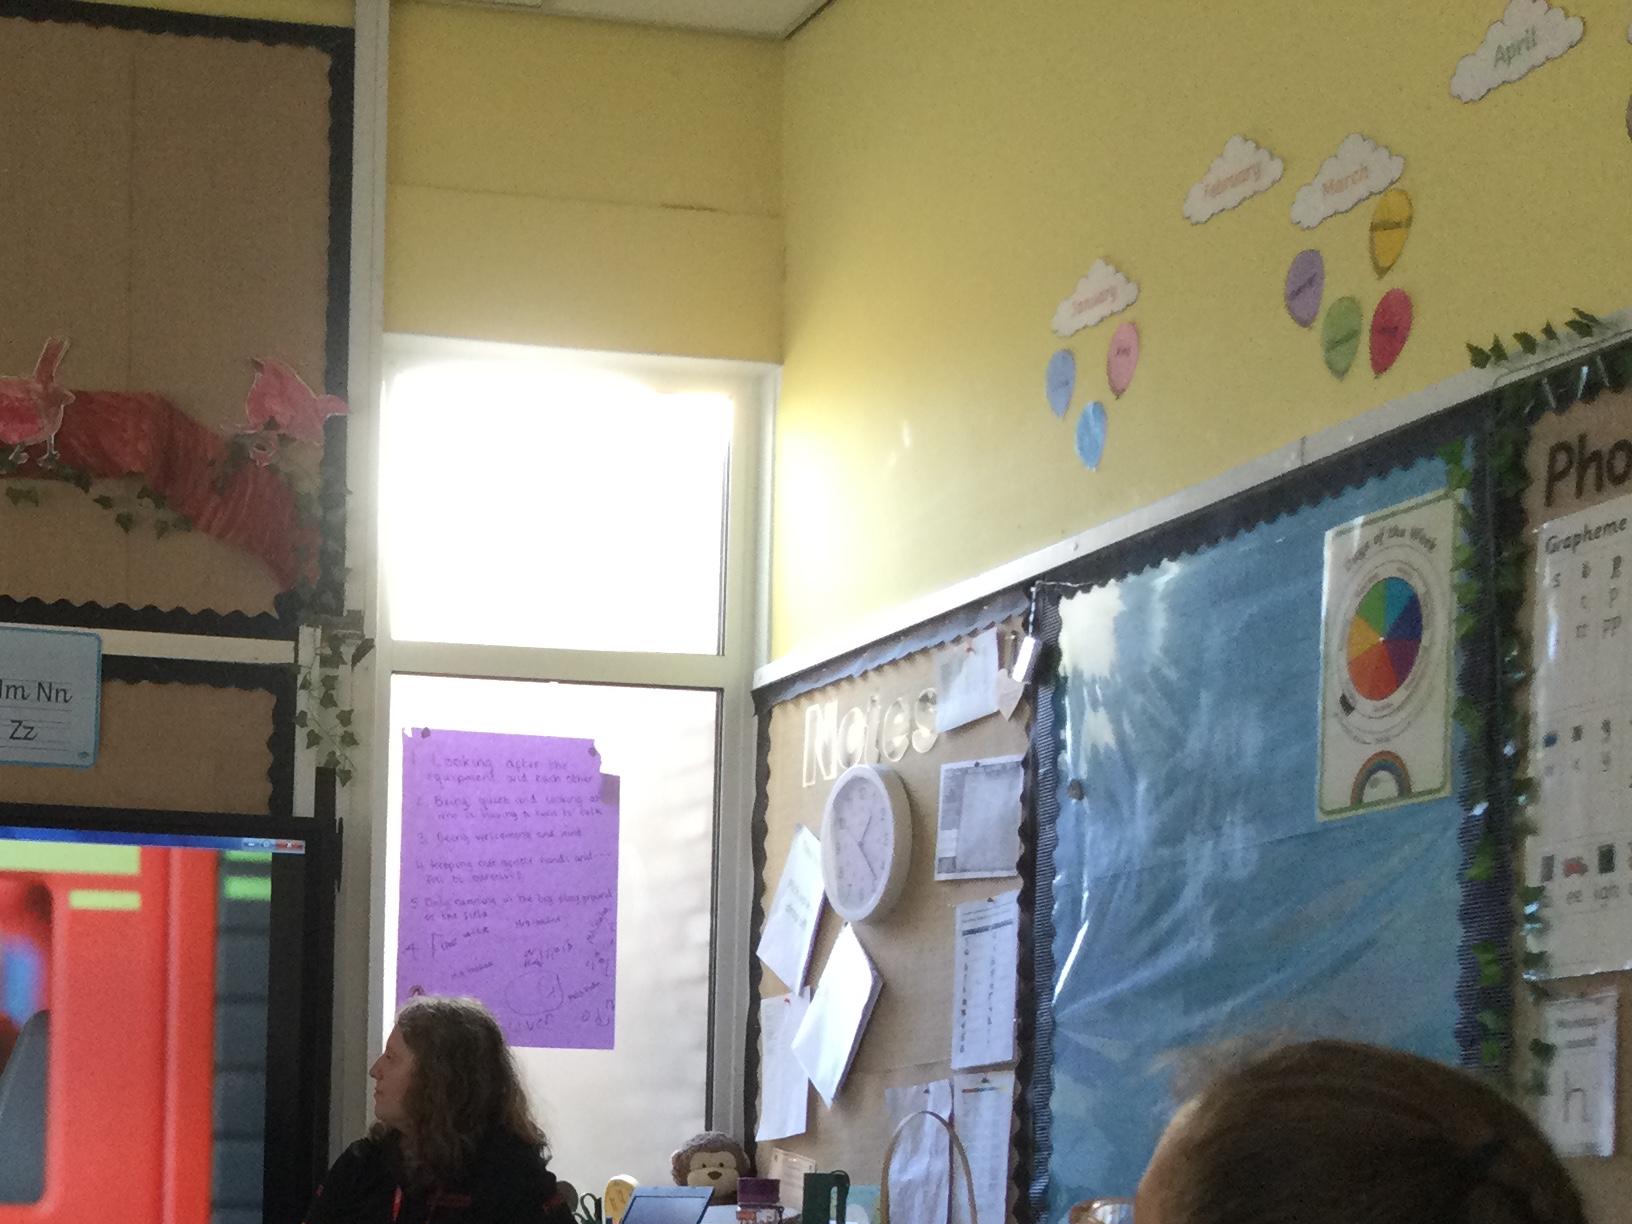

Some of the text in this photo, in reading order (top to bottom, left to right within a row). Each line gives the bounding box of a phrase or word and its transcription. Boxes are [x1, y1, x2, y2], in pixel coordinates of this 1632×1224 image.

[1493, 25, 1538, 69] April
[1322, 165, 1369, 195] March
[1545, 518, 1628, 556] Grapheme
[36, 681, 73, 704] Nn
[9, 719, 39, 742] Zz
[802, 687, 939, 788] Notes
[431, 753, 495, 778] Looking
[506, 757, 539, 772] after
